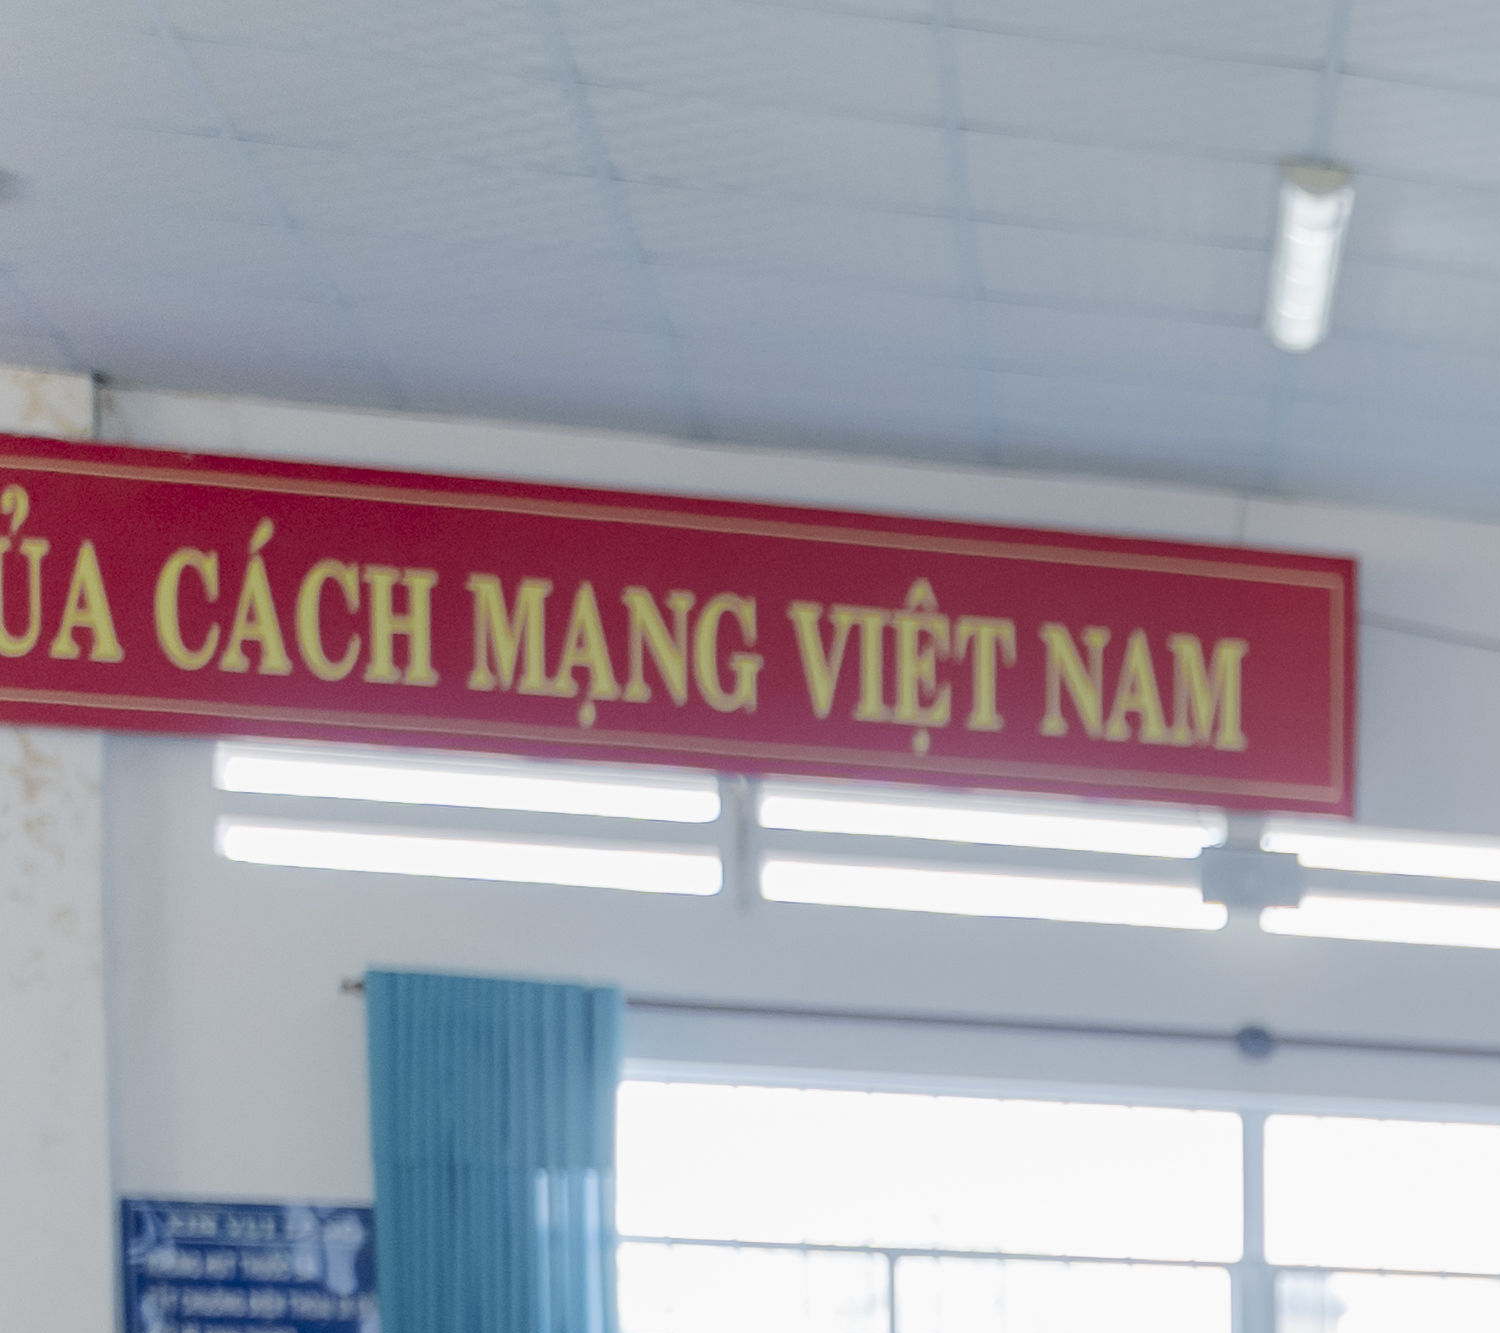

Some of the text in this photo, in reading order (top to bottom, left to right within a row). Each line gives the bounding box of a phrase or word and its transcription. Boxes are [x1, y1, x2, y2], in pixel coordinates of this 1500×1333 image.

[154, 516, 438, 687] CÁCH
[465, 572, 764, 728] MẠNG
[787, 577, 1017, 756] VIỆT
[1040, 622, 1249, 751] NAM
